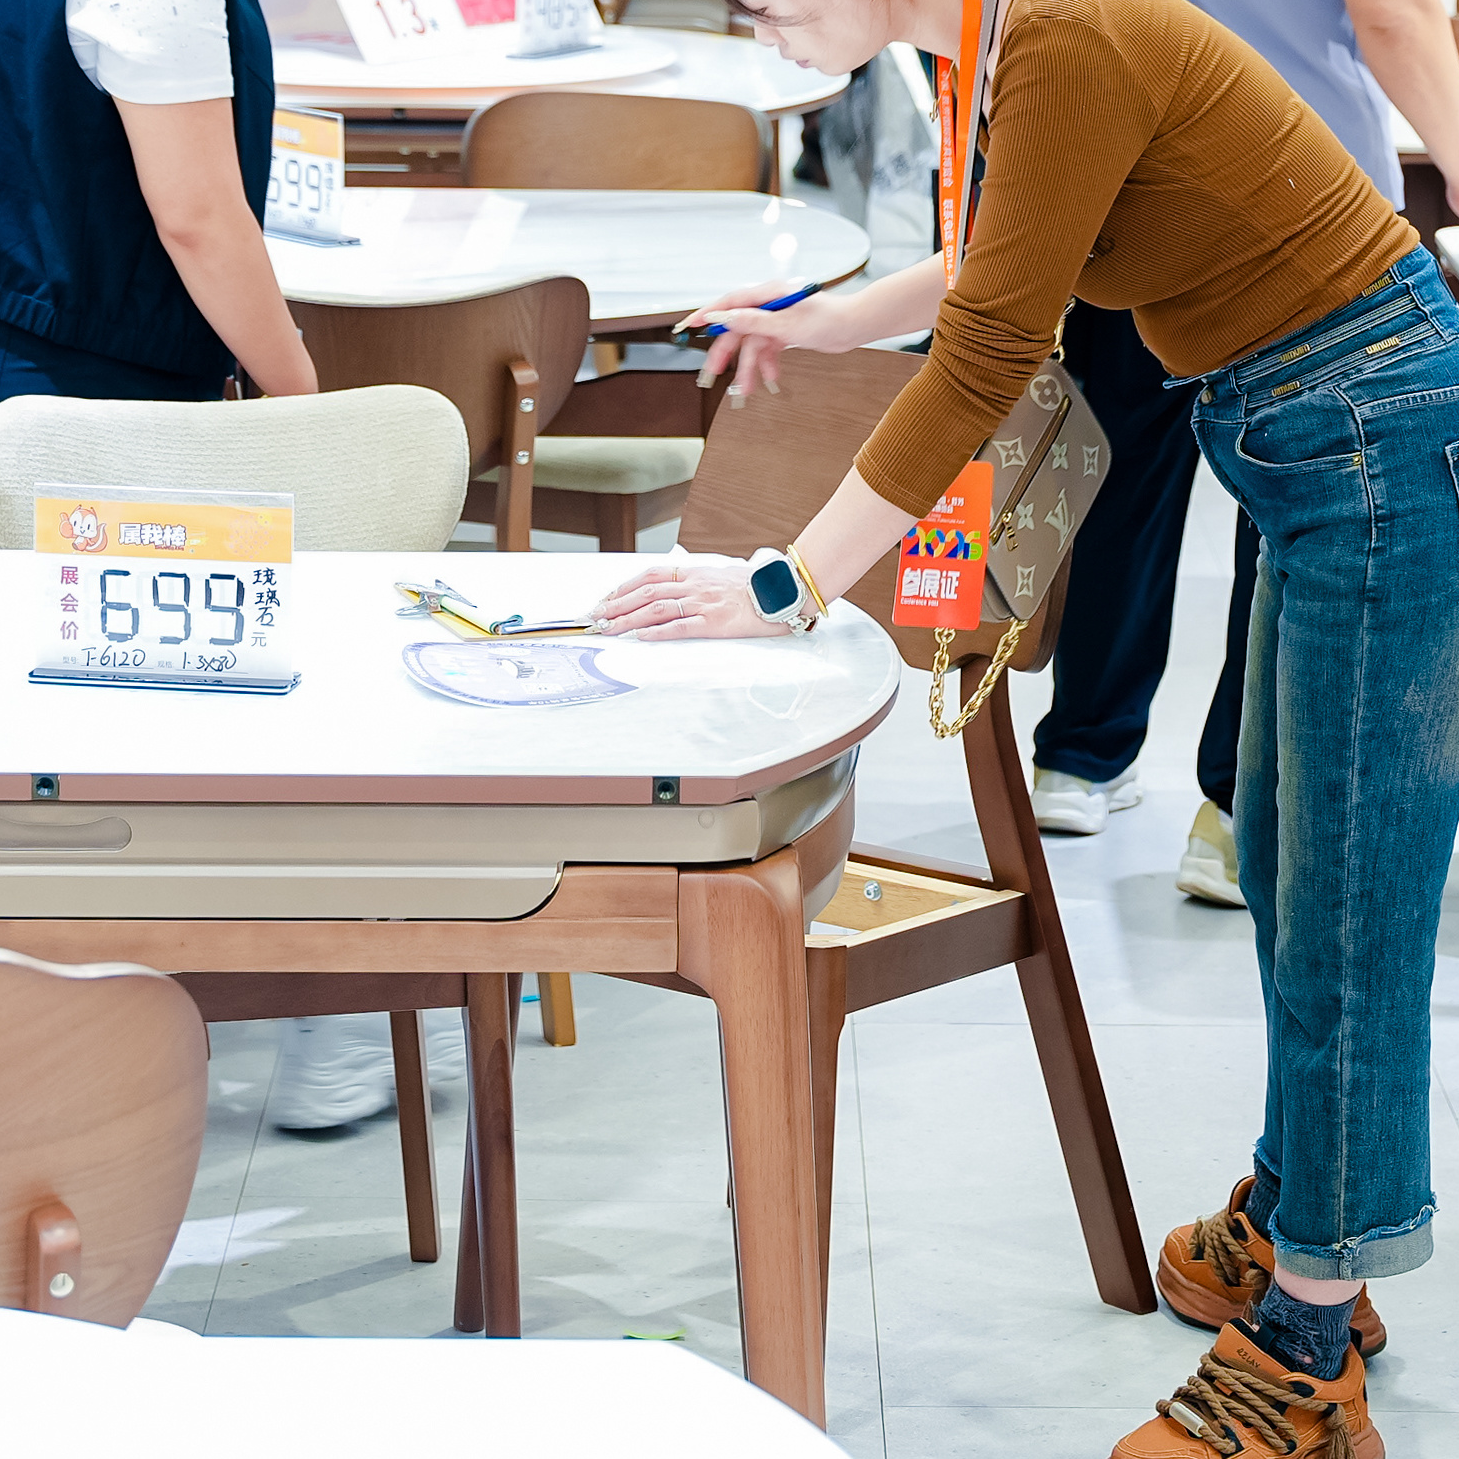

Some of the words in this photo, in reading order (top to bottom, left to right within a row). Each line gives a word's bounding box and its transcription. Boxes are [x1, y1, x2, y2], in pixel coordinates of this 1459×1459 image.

[117, 522, 188, 547] 属我棒
[905, 525, 984, 561] 2026
[900, 566, 962, 600] 参展证
[60, 566, 79, 641] 展会价
[99, 569, 245, 646] 699
